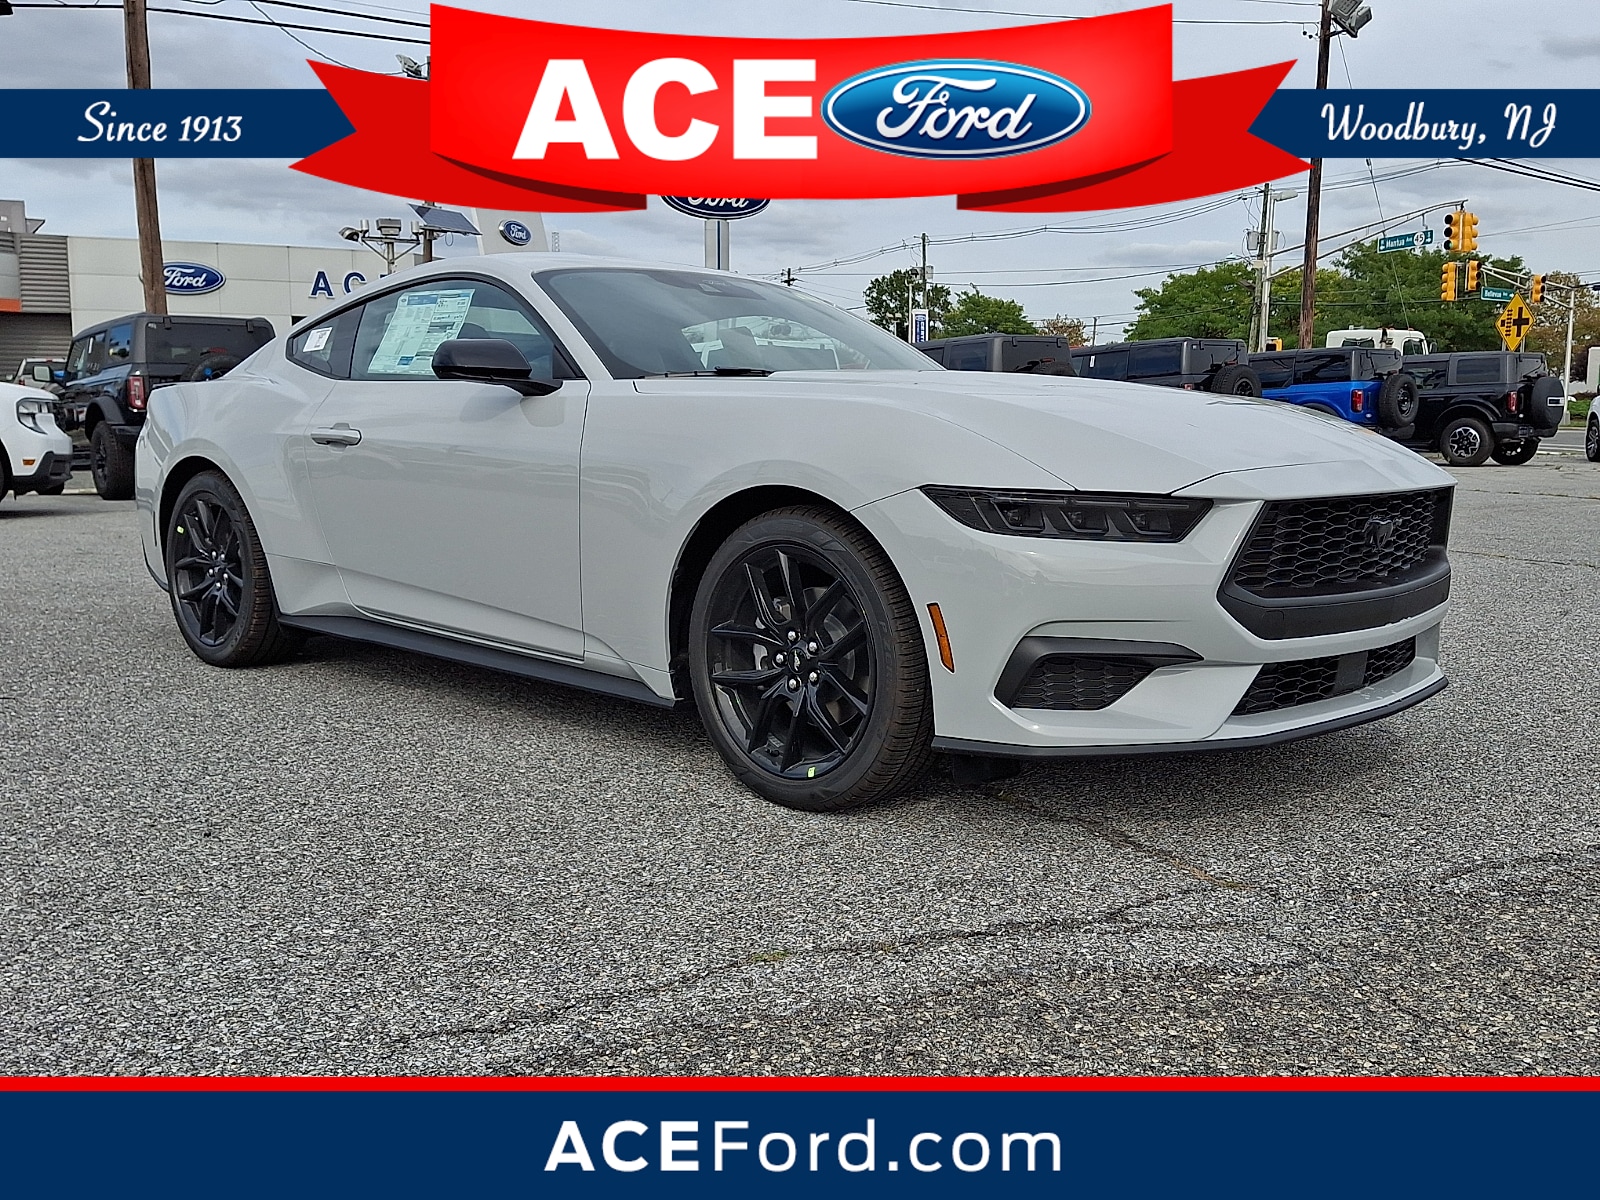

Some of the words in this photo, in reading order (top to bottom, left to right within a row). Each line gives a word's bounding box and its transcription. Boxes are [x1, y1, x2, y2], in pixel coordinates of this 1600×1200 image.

[510, 224, 527, 240] Ford
[1414, 233, 1424, 242] 45
[163, 266, 208, 287] Ford
